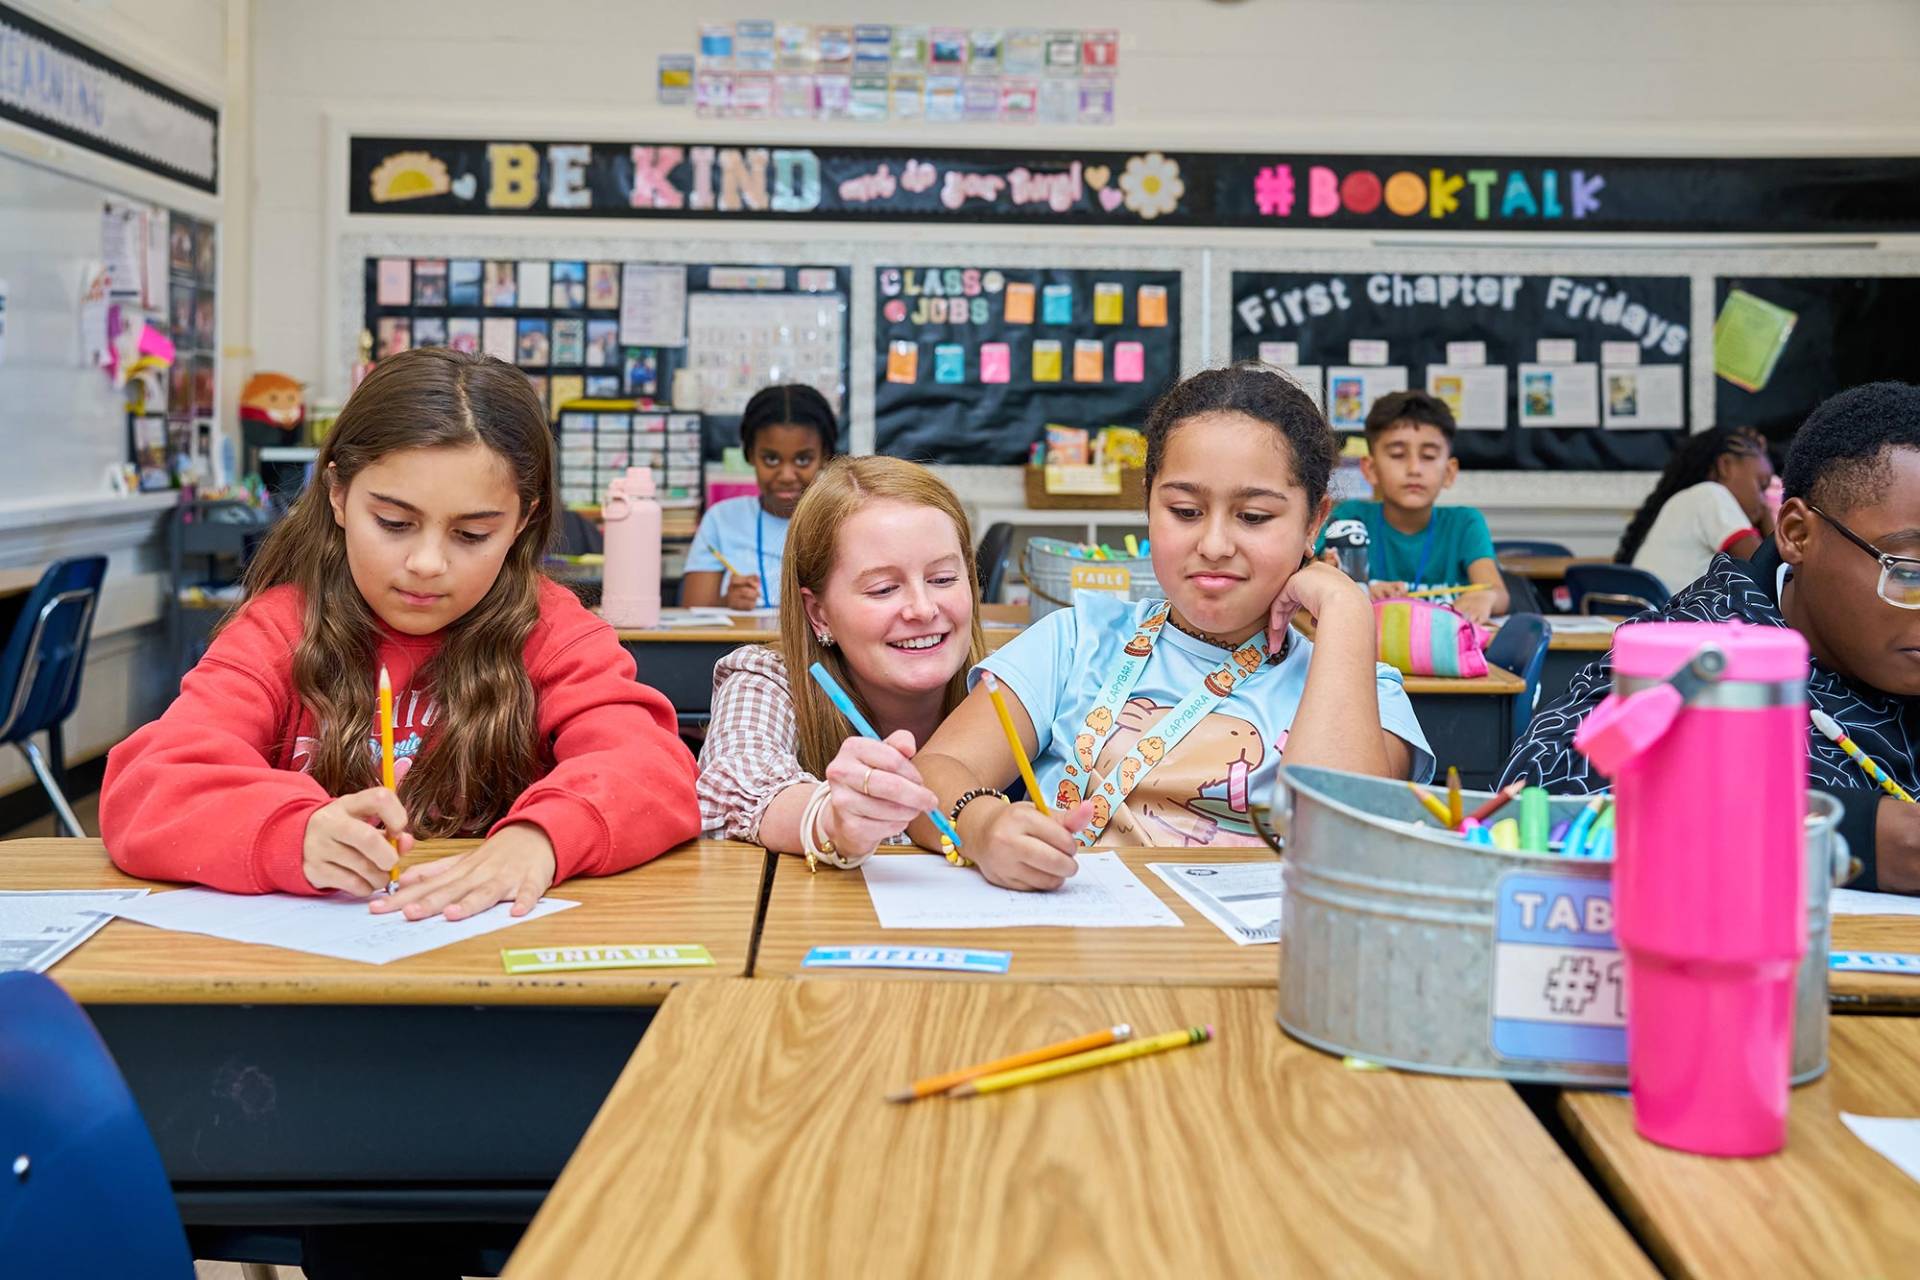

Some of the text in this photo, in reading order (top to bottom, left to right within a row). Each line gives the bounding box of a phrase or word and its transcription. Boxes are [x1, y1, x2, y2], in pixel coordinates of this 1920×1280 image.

[486, 143, 821, 212] BE KIND
[881, 268, 982, 296] CLASS
[910, 297, 990, 326] JOBS
[1237, 277, 1352, 334] First
[1546, 277, 1688, 356] Fridays
[1076, 572, 1123, 586] TABLE
[1106, 659, 1138, 704] CAPYBARA
[1164, 693, 1210, 738] CAPYBARA
[1513, 892, 1614, 934] TAB
